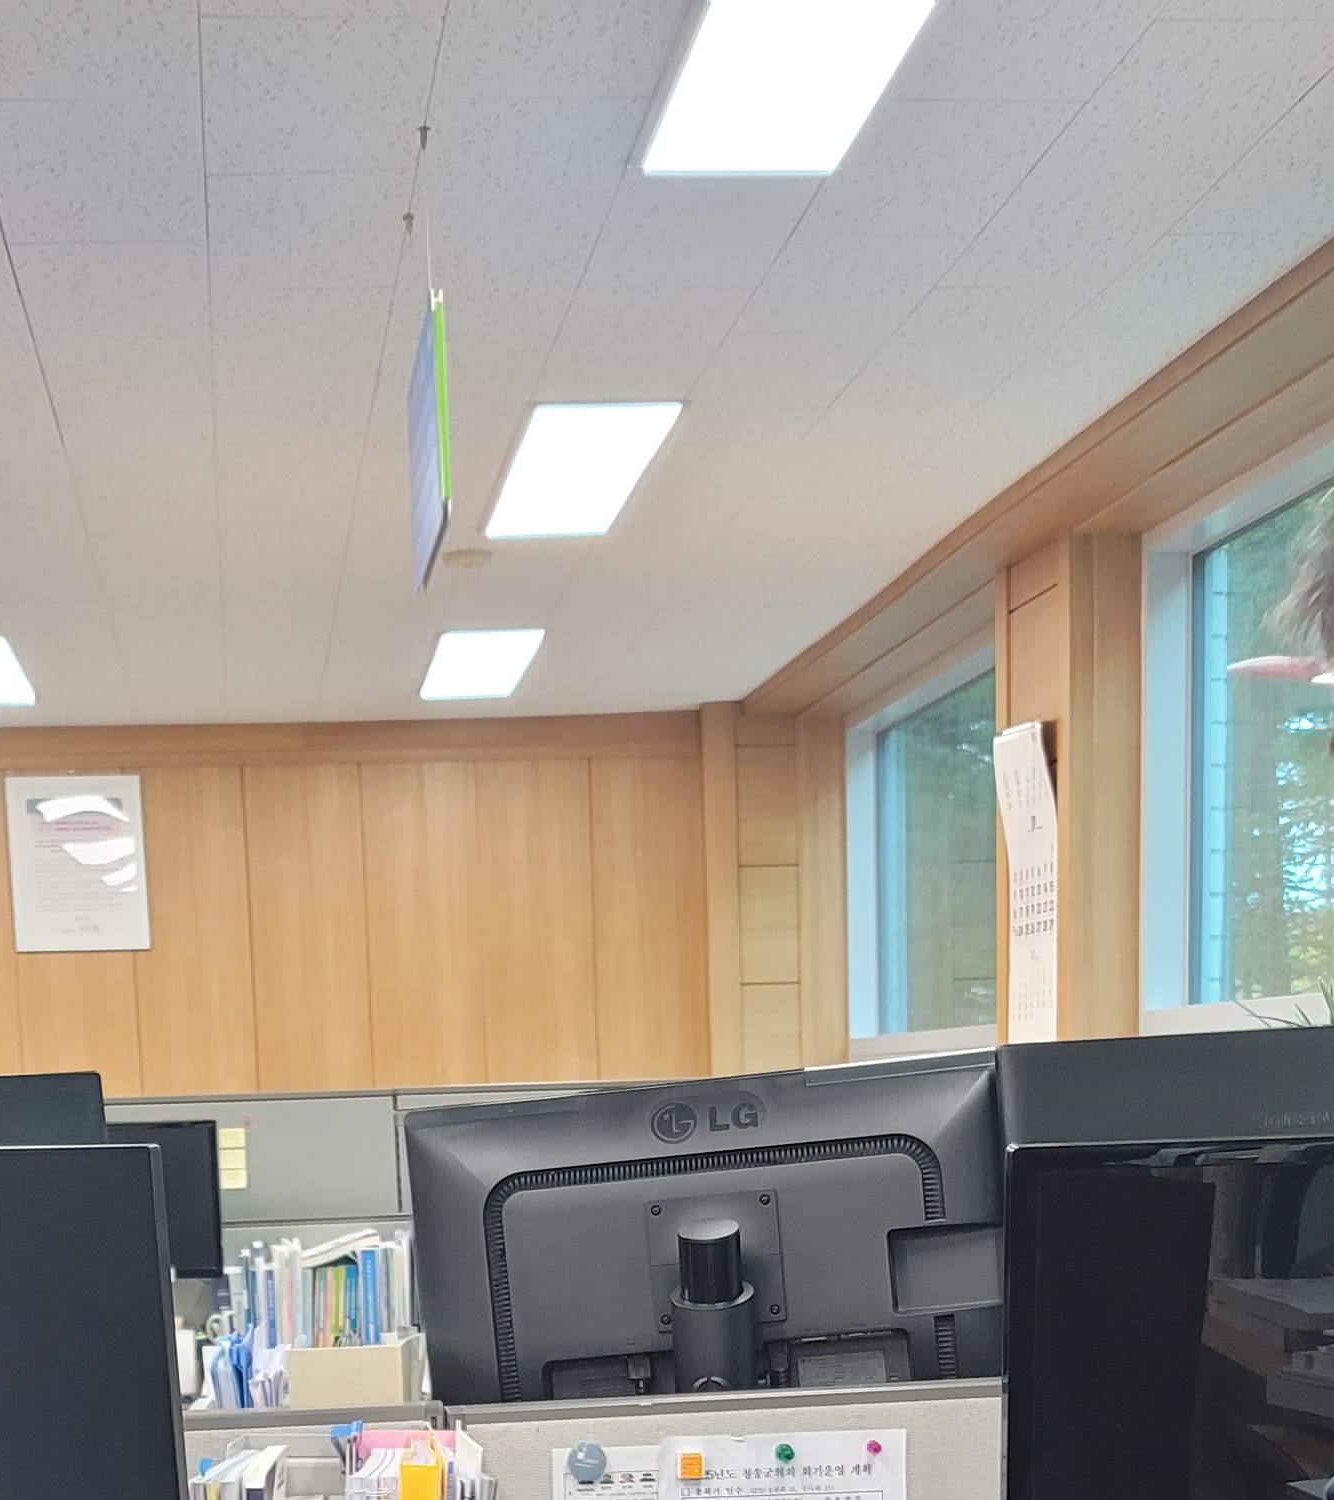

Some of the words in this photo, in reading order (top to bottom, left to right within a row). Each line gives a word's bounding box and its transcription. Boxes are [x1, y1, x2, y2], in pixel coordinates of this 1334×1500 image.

[709, 1101, 759, 1133] LG
[801, 1464, 844, 1478] 회기운영
[850, 1463, 872, 1476] 계획
